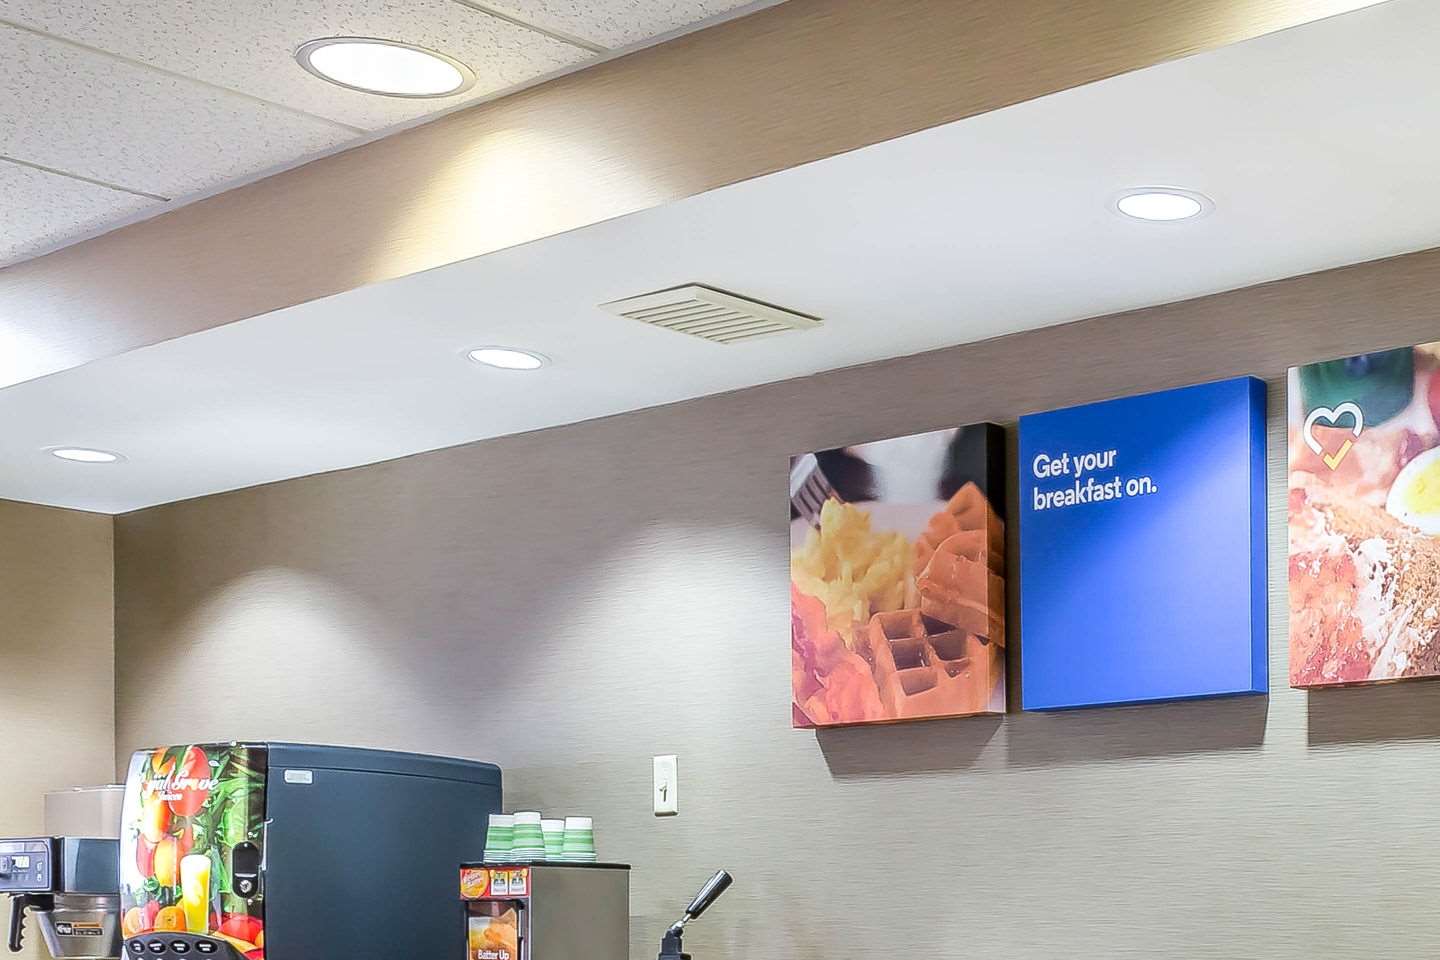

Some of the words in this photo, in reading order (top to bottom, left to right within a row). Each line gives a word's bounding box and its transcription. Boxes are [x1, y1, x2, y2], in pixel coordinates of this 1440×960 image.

[1032, 452, 1070, 479] Get
[1073, 449, 1118, 478] your
[1033, 476, 1122, 511] breakfast
[1125, 476, 1158, 497] on.
